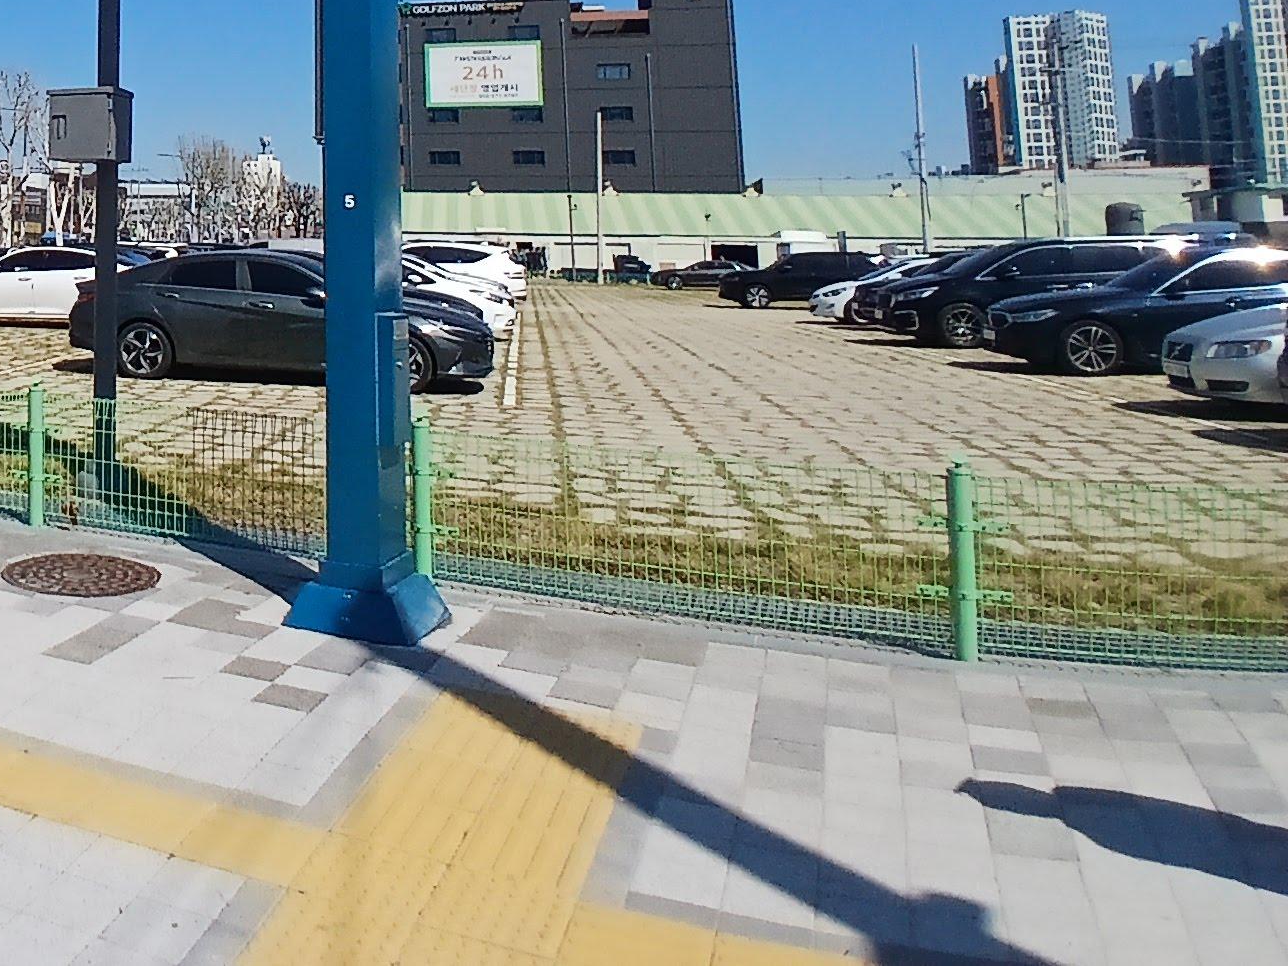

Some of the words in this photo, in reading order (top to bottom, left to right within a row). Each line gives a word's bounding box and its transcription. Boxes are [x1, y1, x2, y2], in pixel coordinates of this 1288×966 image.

[412, 4, 457, 14] GOLFZON
[459, 2, 485, 12] PARK
[462, 64, 504, 80] 24h
[344, 194, 355, 208] 5
